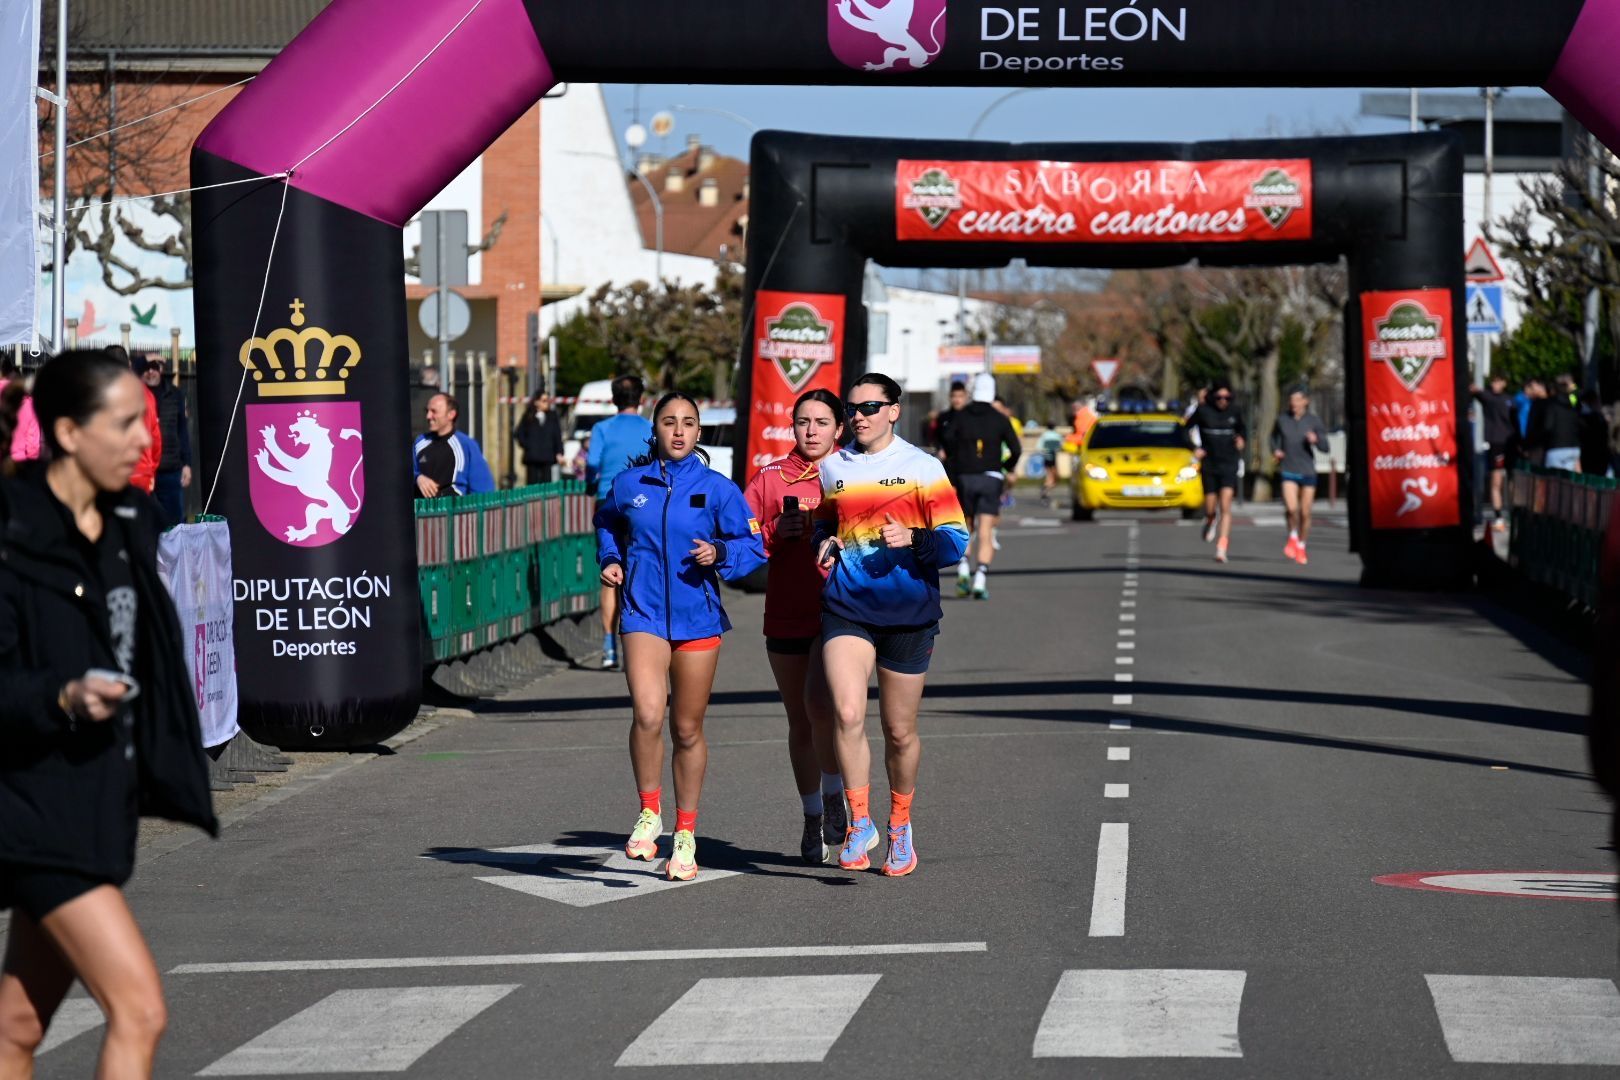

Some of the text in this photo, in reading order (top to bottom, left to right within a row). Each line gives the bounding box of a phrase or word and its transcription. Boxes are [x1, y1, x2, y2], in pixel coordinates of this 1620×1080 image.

[981, 0, 1187, 41] DE LEÓN
[979, 51, 1125, 73] Deportes
[958, 202, 1247, 236] cuatro cantones
[233, 569, 391, 601] DIPUTACIÓN
[256, 600, 371, 631] DE LEÓN
[272, 639, 357, 661] Deportes
